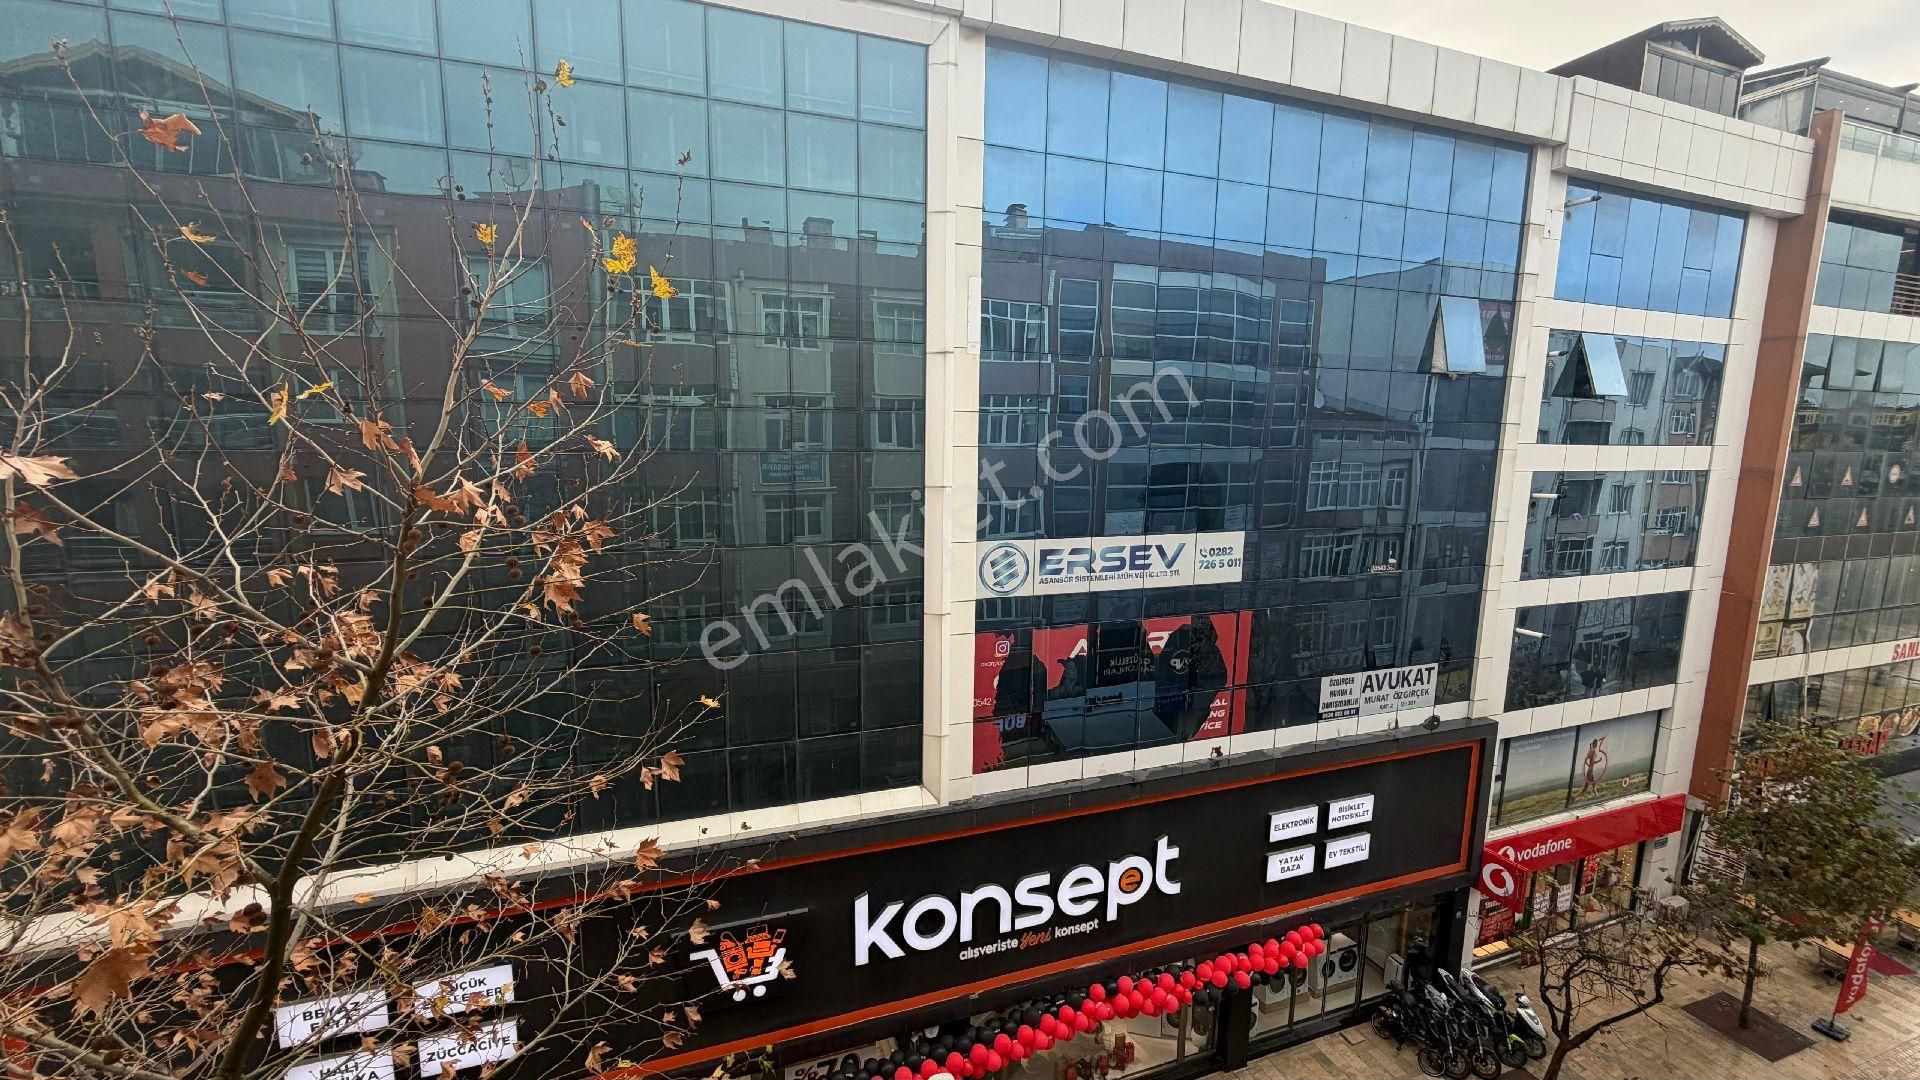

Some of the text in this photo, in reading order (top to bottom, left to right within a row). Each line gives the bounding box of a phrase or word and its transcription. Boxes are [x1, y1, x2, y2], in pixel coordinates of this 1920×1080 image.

[1039, 541, 1187, 577] ERSEV
[1208, 546, 1234, 558] 0282
[1198, 557, 1242, 570] 726 5 011
[1039, 575, 1074, 585] ASANSÖR
[1074, 572, 1116, 582] SİSTEMLERİ
[1361, 666, 1436, 694] AVUKAT
[1364, 687, 1431, 705] MURAT ÖZGİRÇEK
[1331, 809, 1370, 823] MOTOSİKLET
[1338, 802, 1366, 814] BİSİKLET
[1273, 815, 1315, 832] ELEKTRONİK
[1328, 842, 1367, 859] EV TEKSTİLİ
[1516, 837, 1573, 862] vodafone
[1278, 853, 1305, 866] YATAK
[1280, 864, 1301, 874] BAZA
[854, 833, 1182, 967] konsept
[959, 917, 1100, 961] alışverişte Yeni konsept
[302, 1001, 361, 1022] BEYZ
[425, 1035, 512, 1063] ZÜCCACİE
